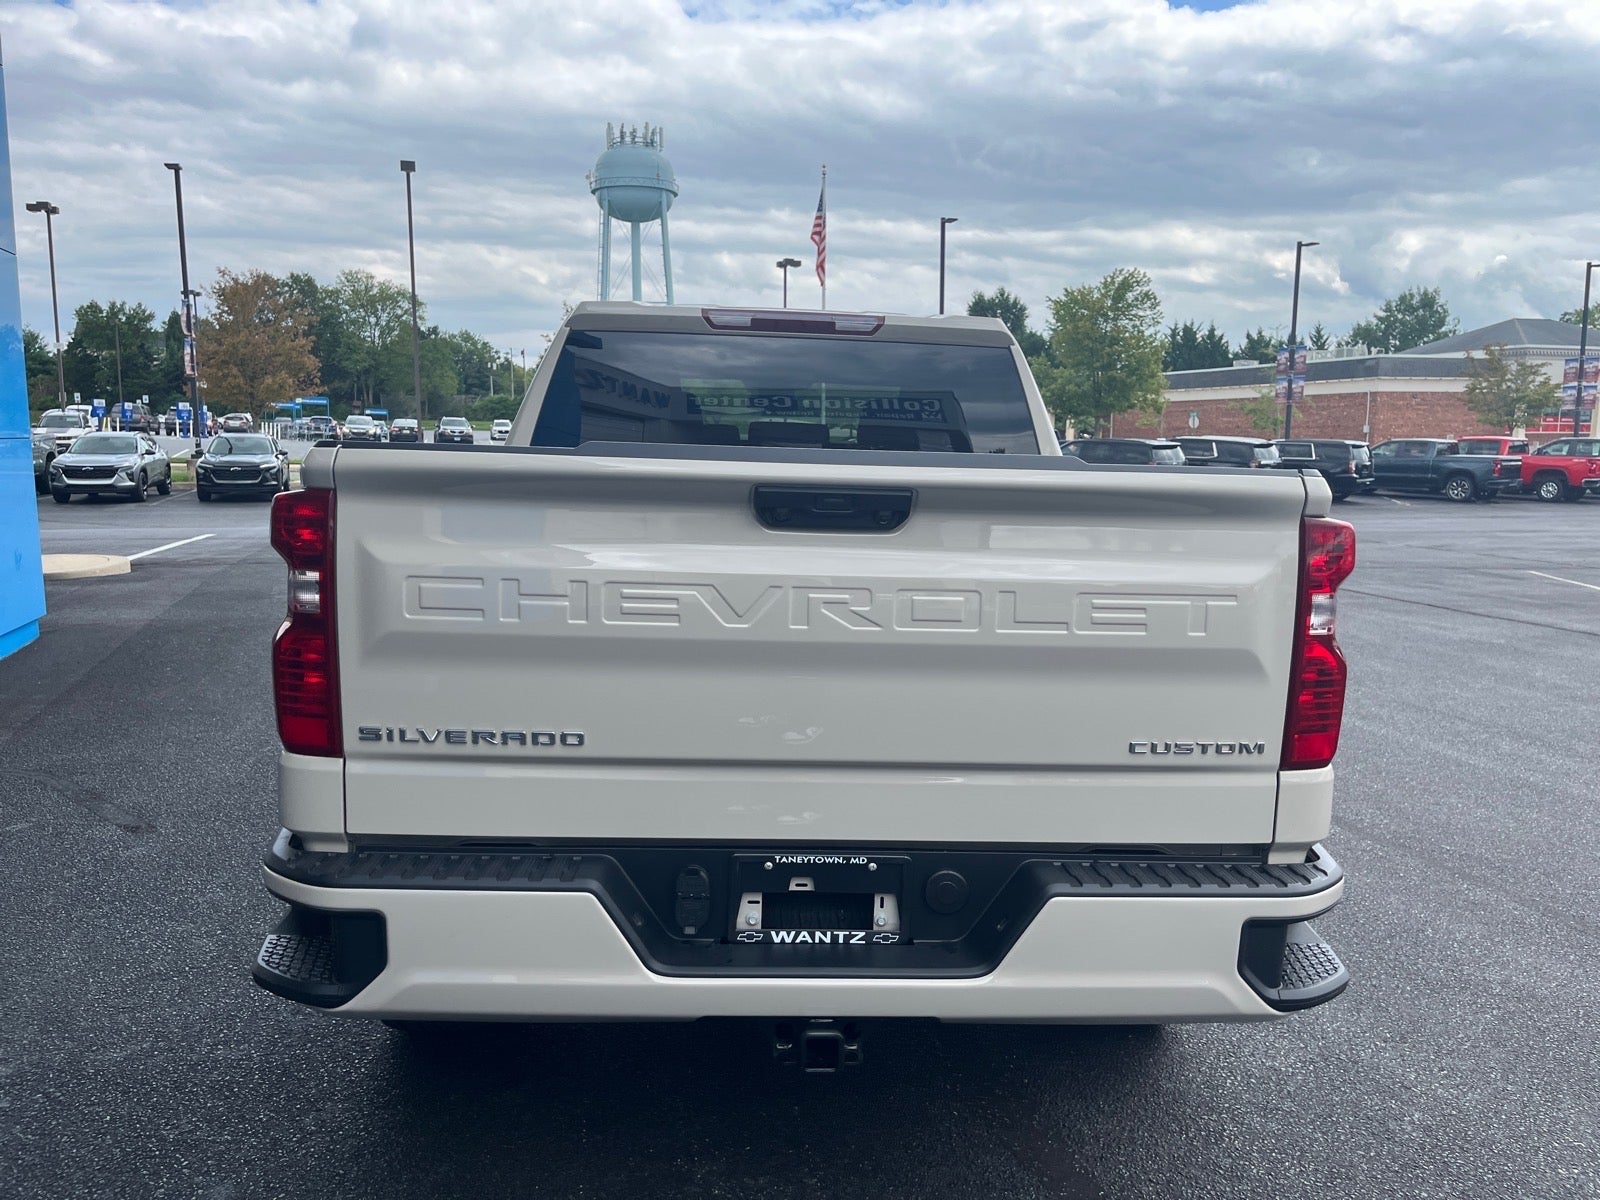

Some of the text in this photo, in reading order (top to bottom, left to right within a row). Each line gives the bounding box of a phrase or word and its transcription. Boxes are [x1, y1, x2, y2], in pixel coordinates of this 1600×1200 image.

[405, 575, 1238, 635] CHEVROLET
[358, 725, 585, 746] SILVERADO
[1128, 741, 1266, 755] CUSTOM
[774, 855, 868, 865] TANEYTOWN, MD
[770, 930, 866, 944] WANTZ
